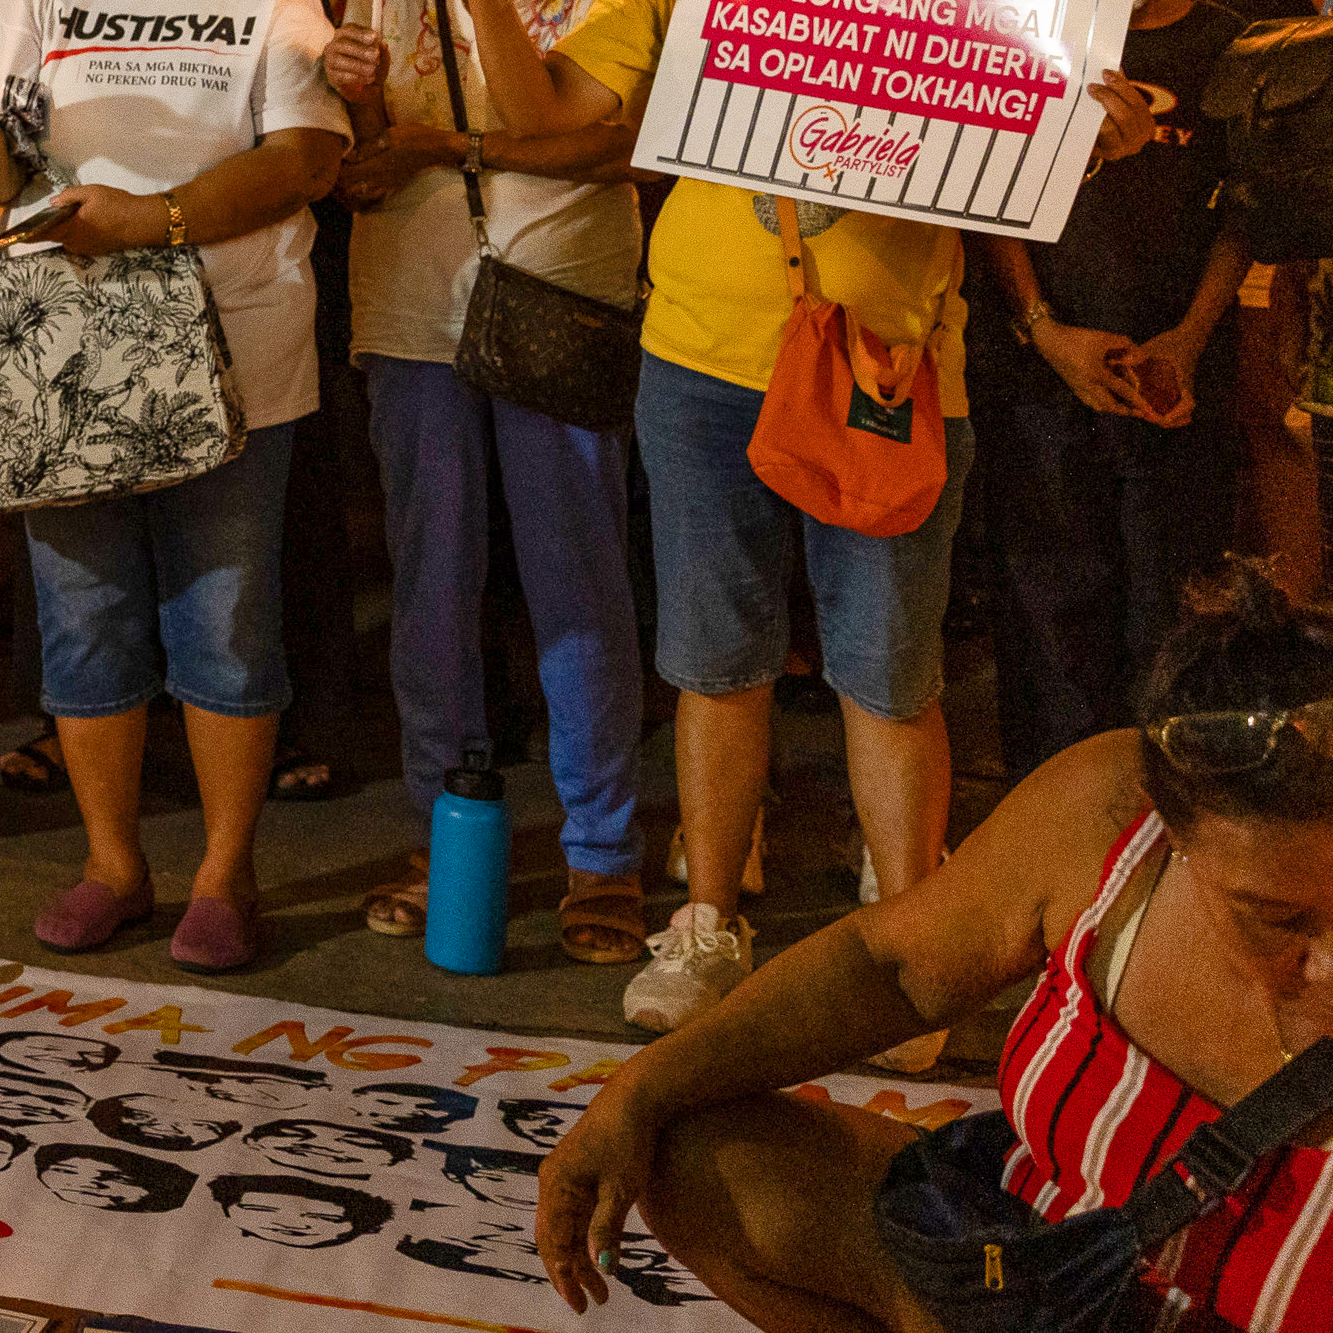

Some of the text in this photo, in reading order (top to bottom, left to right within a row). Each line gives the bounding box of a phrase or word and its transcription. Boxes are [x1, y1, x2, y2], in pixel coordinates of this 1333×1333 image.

[965, 0, 1041, 38] MGA
[711, 2, 1067, 87] KASABWAT NI DUTERTE
[85, 72, 229, 93] NG PEKENG DRUG WAR
[88, 59, 233, 78] PARA SA MGA BIKTIMA
[713, 45, 1040, 123] SA OPLAN TOKHANG!
[799, 115, 922, 168] Gabriela
[833, 152, 909, 179] PARTYLIST
[232, 1019, 433, 1071] NG
